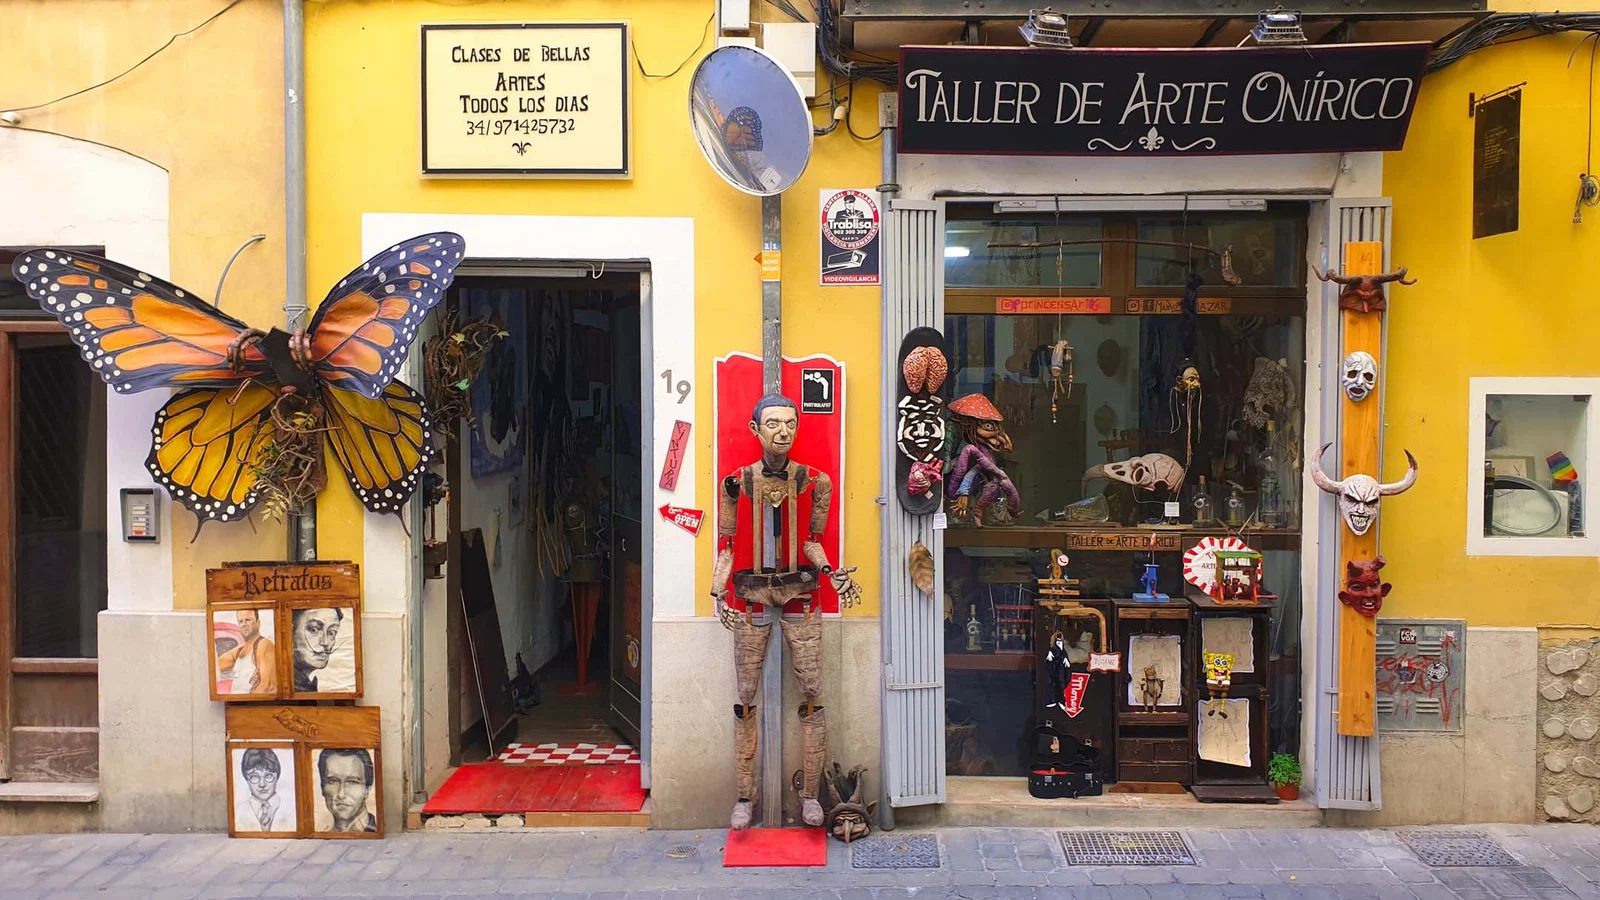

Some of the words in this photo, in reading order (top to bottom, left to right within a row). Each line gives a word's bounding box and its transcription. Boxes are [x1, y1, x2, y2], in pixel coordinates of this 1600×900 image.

[452, 45, 501, 63] CLASES
[514, 48, 530, 62] DE
[541, 45, 590, 61] BELLAS
[495, 72, 546, 91] ARTES
[460, 95, 508, 113] TODOS
[519, 96, 545, 113] LOS
[555, 95, 589, 112] DIAS
[905, 69, 1041, 124] TALLER
[1054, 82, 1104, 125] DE
[1118, 72, 1229, 125] ARTE
[1241, 70, 1414, 123] ONÍRICO
[466, 118, 575, 136] 34/971425732
[828, 219, 872, 230] Trablisa
[660, 369, 691, 404] 19
[664, 421, 686, 488] PINTURA
[675, 513, 699, 528] OPEN
[1070, 536, 1103, 547] TALLER
[1115, 536, 1139, 547] ARTE
[241, 567, 333, 599] Retratos
[1066, 676, 1084, 713] Money
